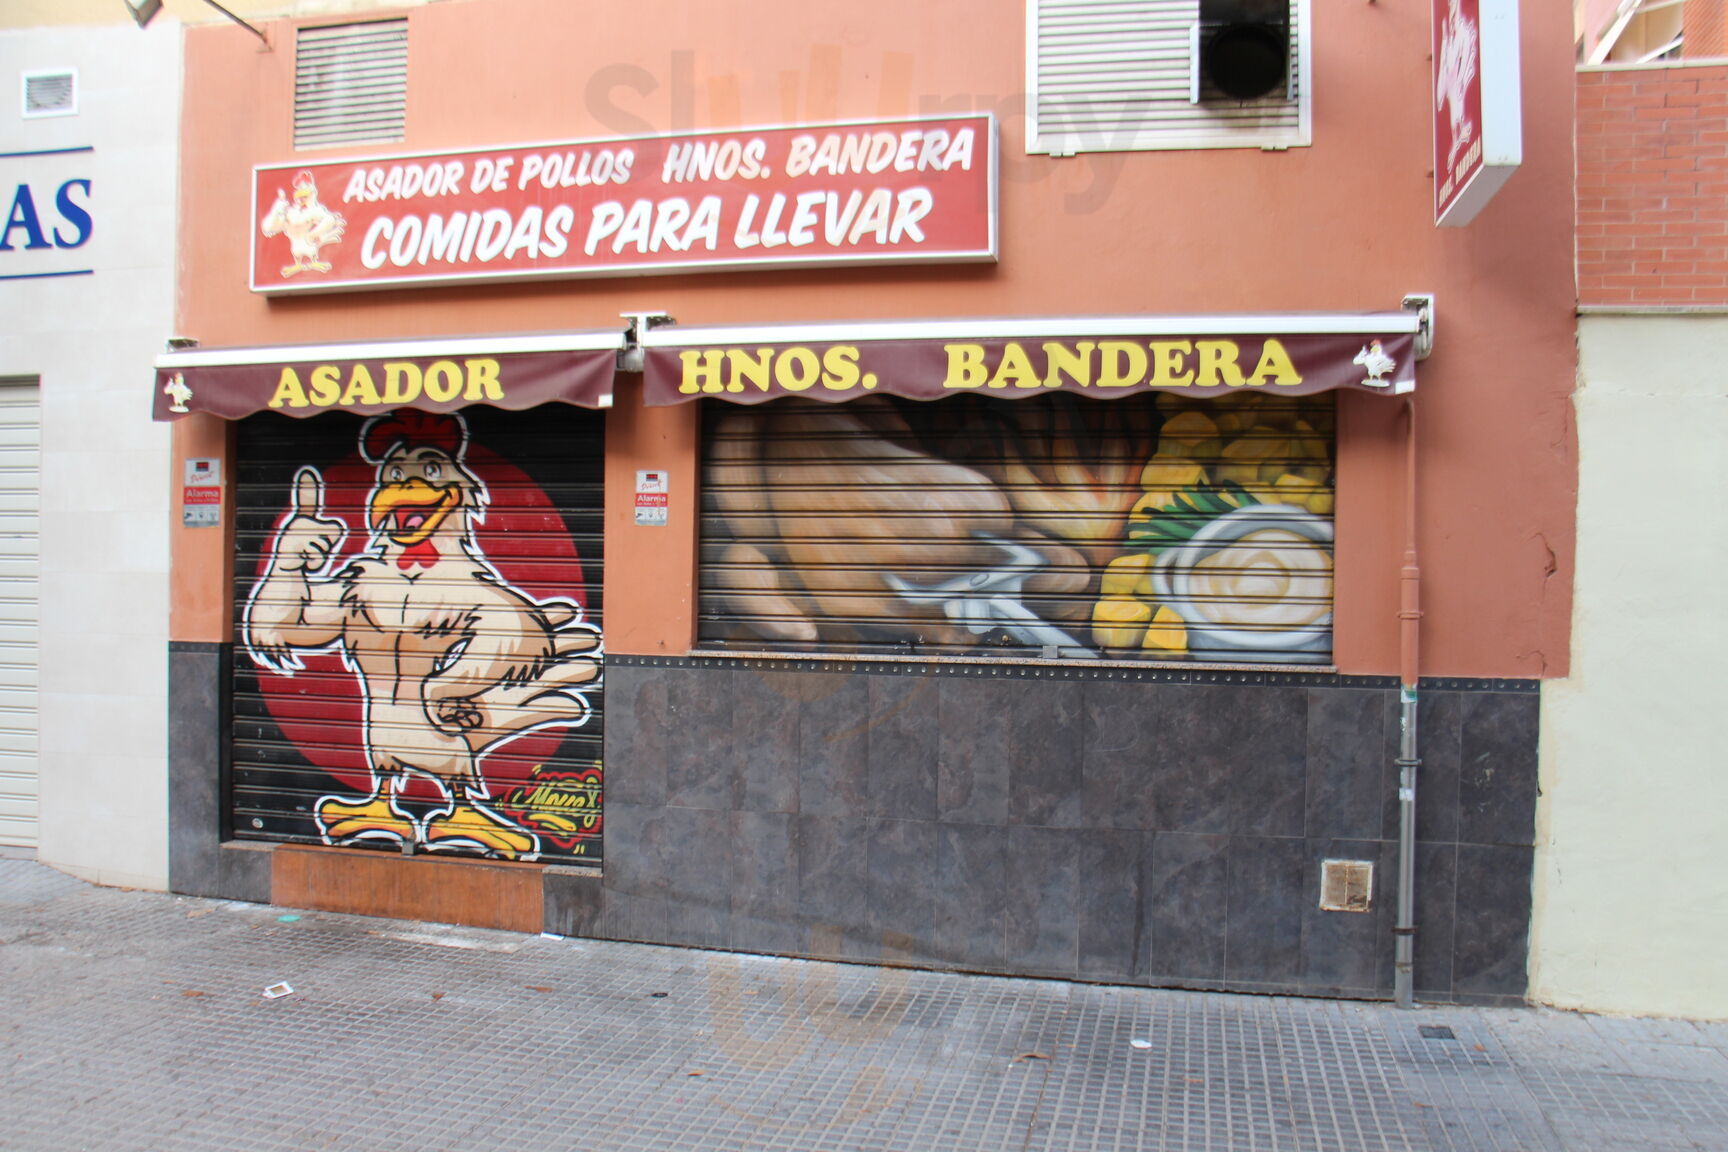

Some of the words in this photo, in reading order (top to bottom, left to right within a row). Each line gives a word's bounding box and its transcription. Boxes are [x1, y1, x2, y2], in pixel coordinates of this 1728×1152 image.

[344, 160, 461, 204] ASADOR
[470, 156, 515, 193] DE
[518, 149, 634, 190] POLLOS
[661, 139, 771, 184] HNOS.
[785, 127, 975, 178] BANDERA
[361, 204, 574, 269] COMIDAS
[584, 195, 721, 256] PARA
[733, 187, 933, 250] LLEVAR
[271, 358, 504, 408] ASADOR
[678, 345, 879, 395] HNOS.
[942, 338, 1304, 391] BANDERA
